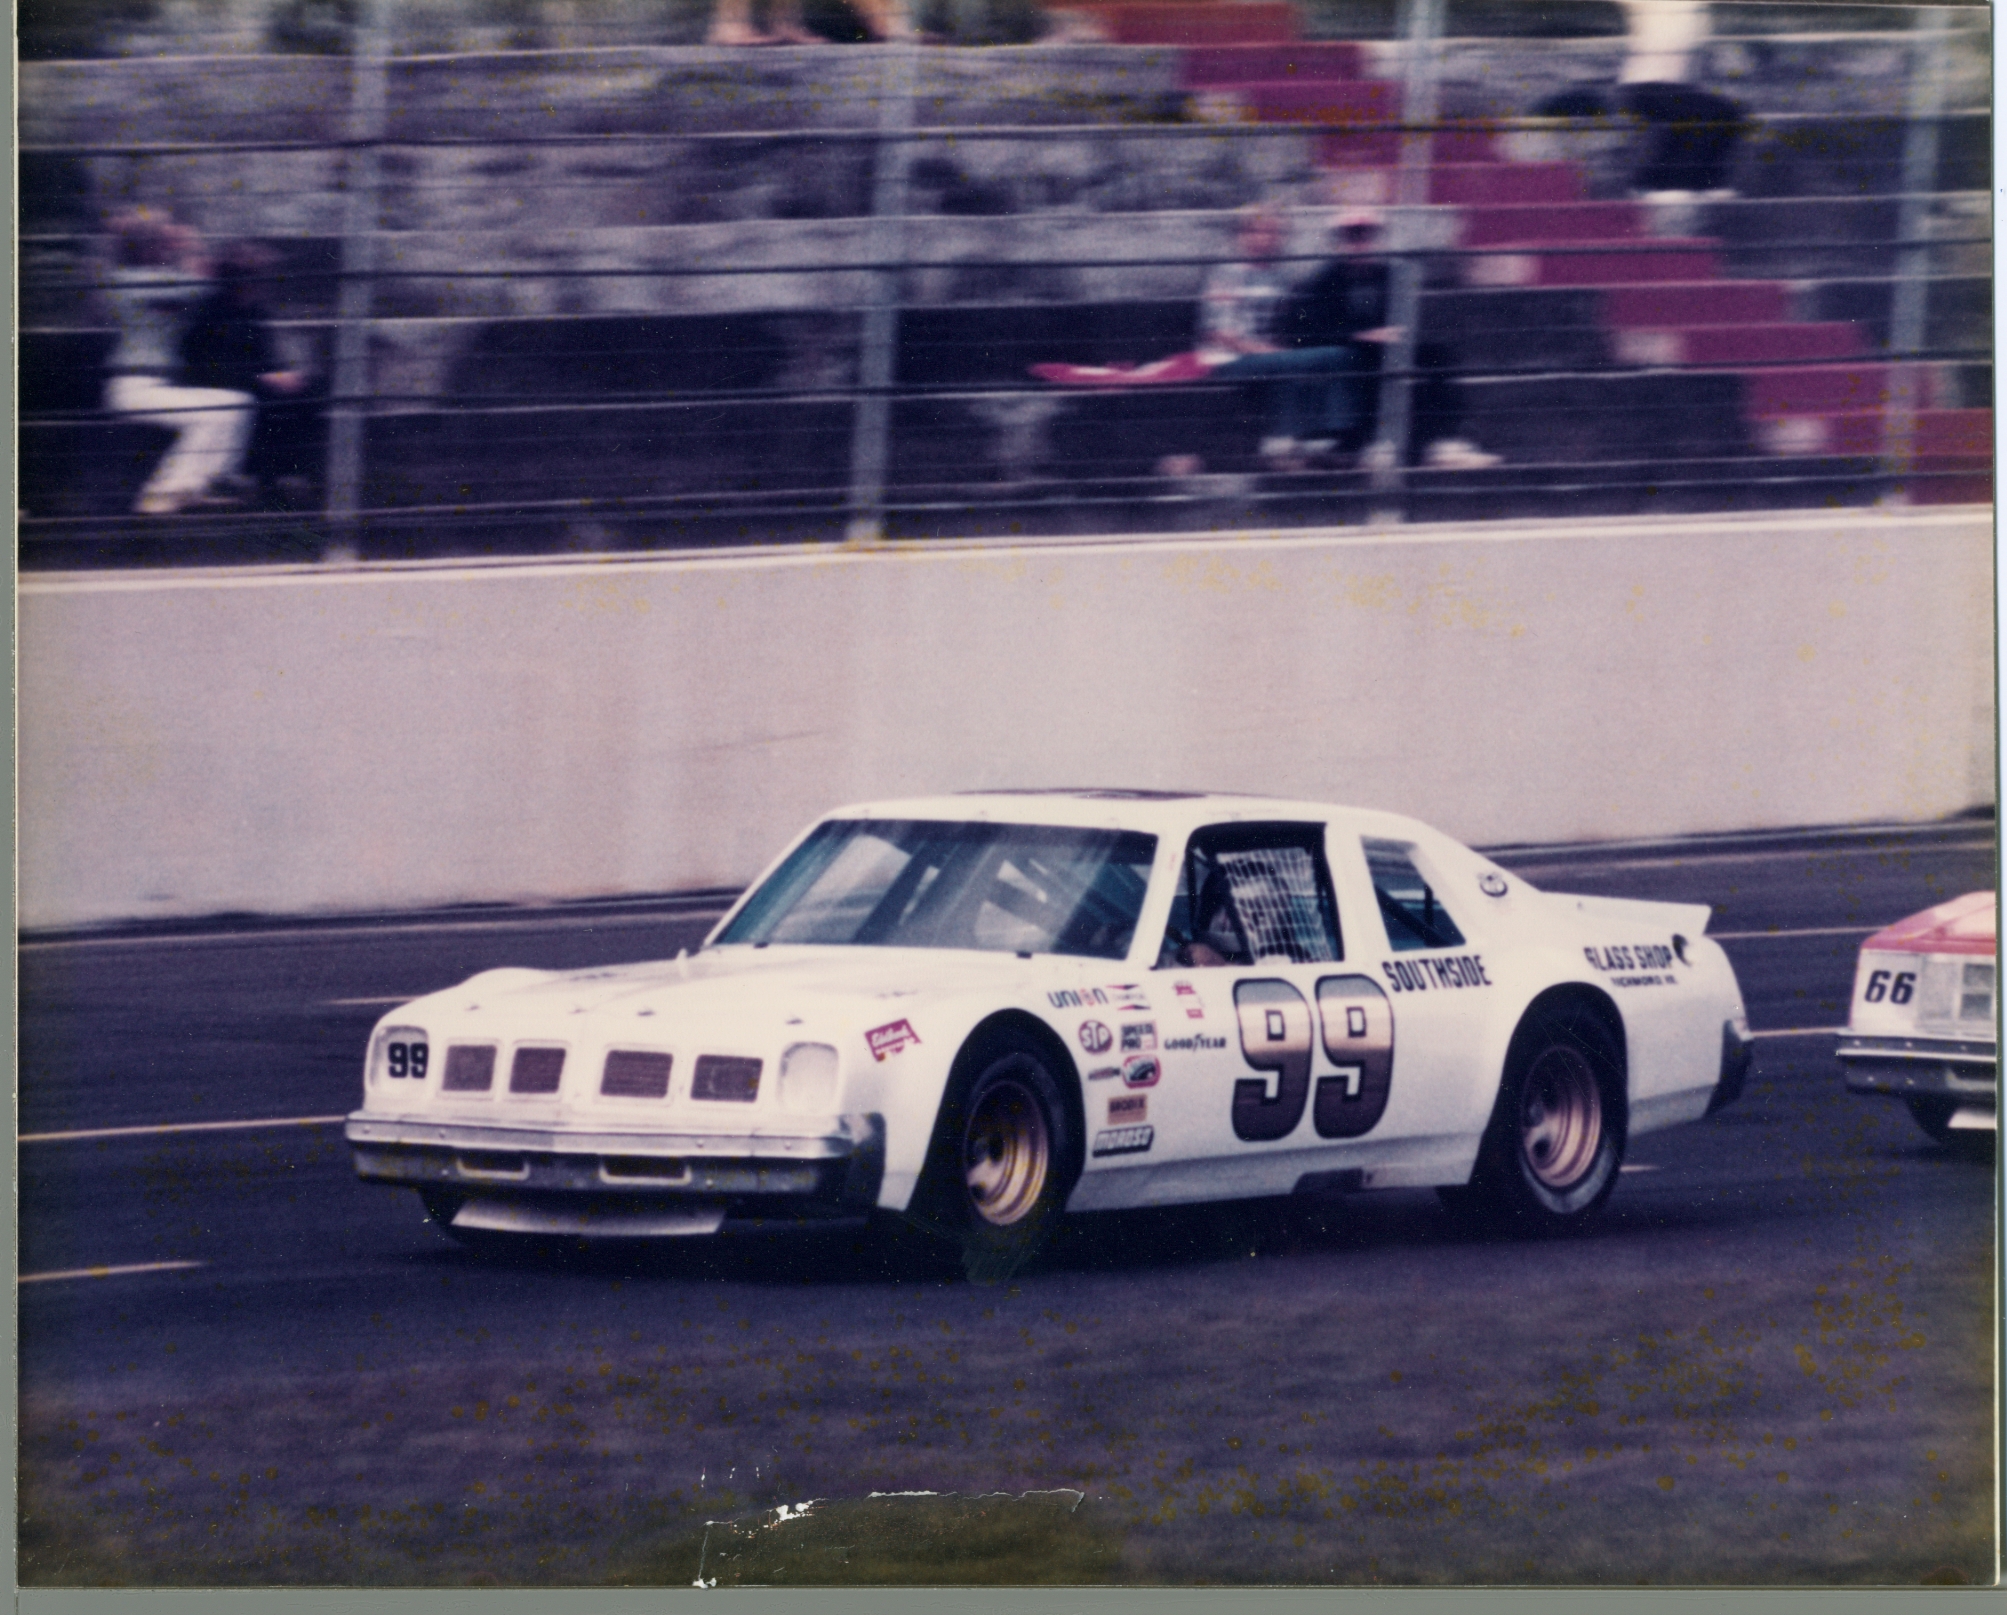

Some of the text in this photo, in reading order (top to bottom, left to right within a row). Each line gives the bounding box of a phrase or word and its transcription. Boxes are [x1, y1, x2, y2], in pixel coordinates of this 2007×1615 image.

[1382, 955, 1492, 992] SOUTHSIDE
[1583, 944, 1673, 970] GLASS SHOP
[1864, 970, 1917, 1005] 66
[1081, 1021, 1110, 1051] STP
[1164, 1033, 1227, 1053] GOODYEAR
[388, 1042, 429, 1079] 99
[1231, 973, 1395, 1142] 99
